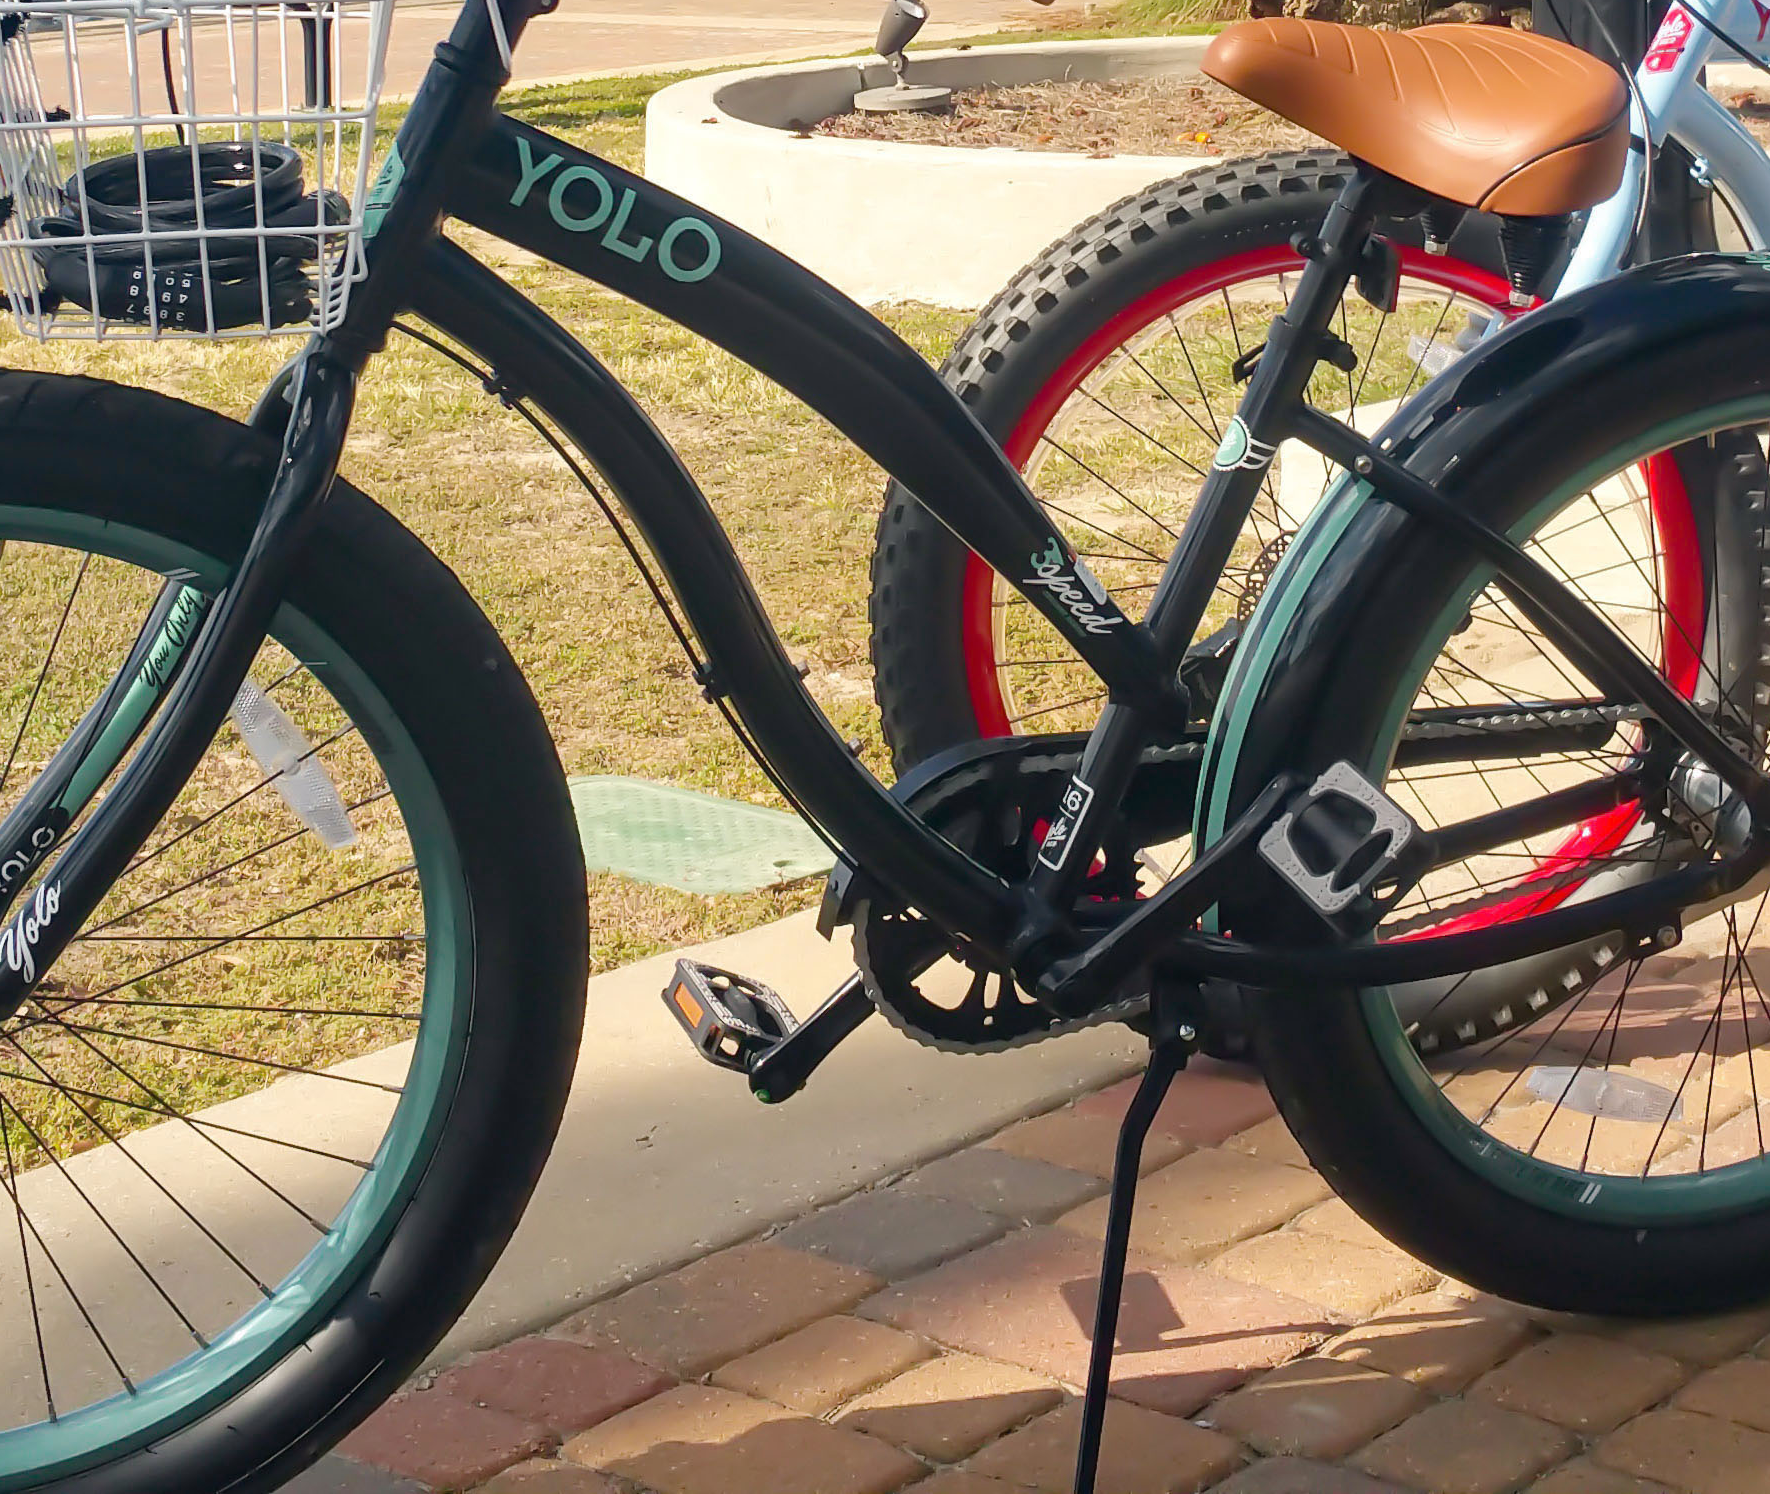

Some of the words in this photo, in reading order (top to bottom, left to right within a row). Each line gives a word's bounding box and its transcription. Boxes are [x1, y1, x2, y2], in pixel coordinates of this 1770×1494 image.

[510, 136, 721, 282] YOLO
[139, 642, 169, 693] You
[166, 589, 203, 647] Only
